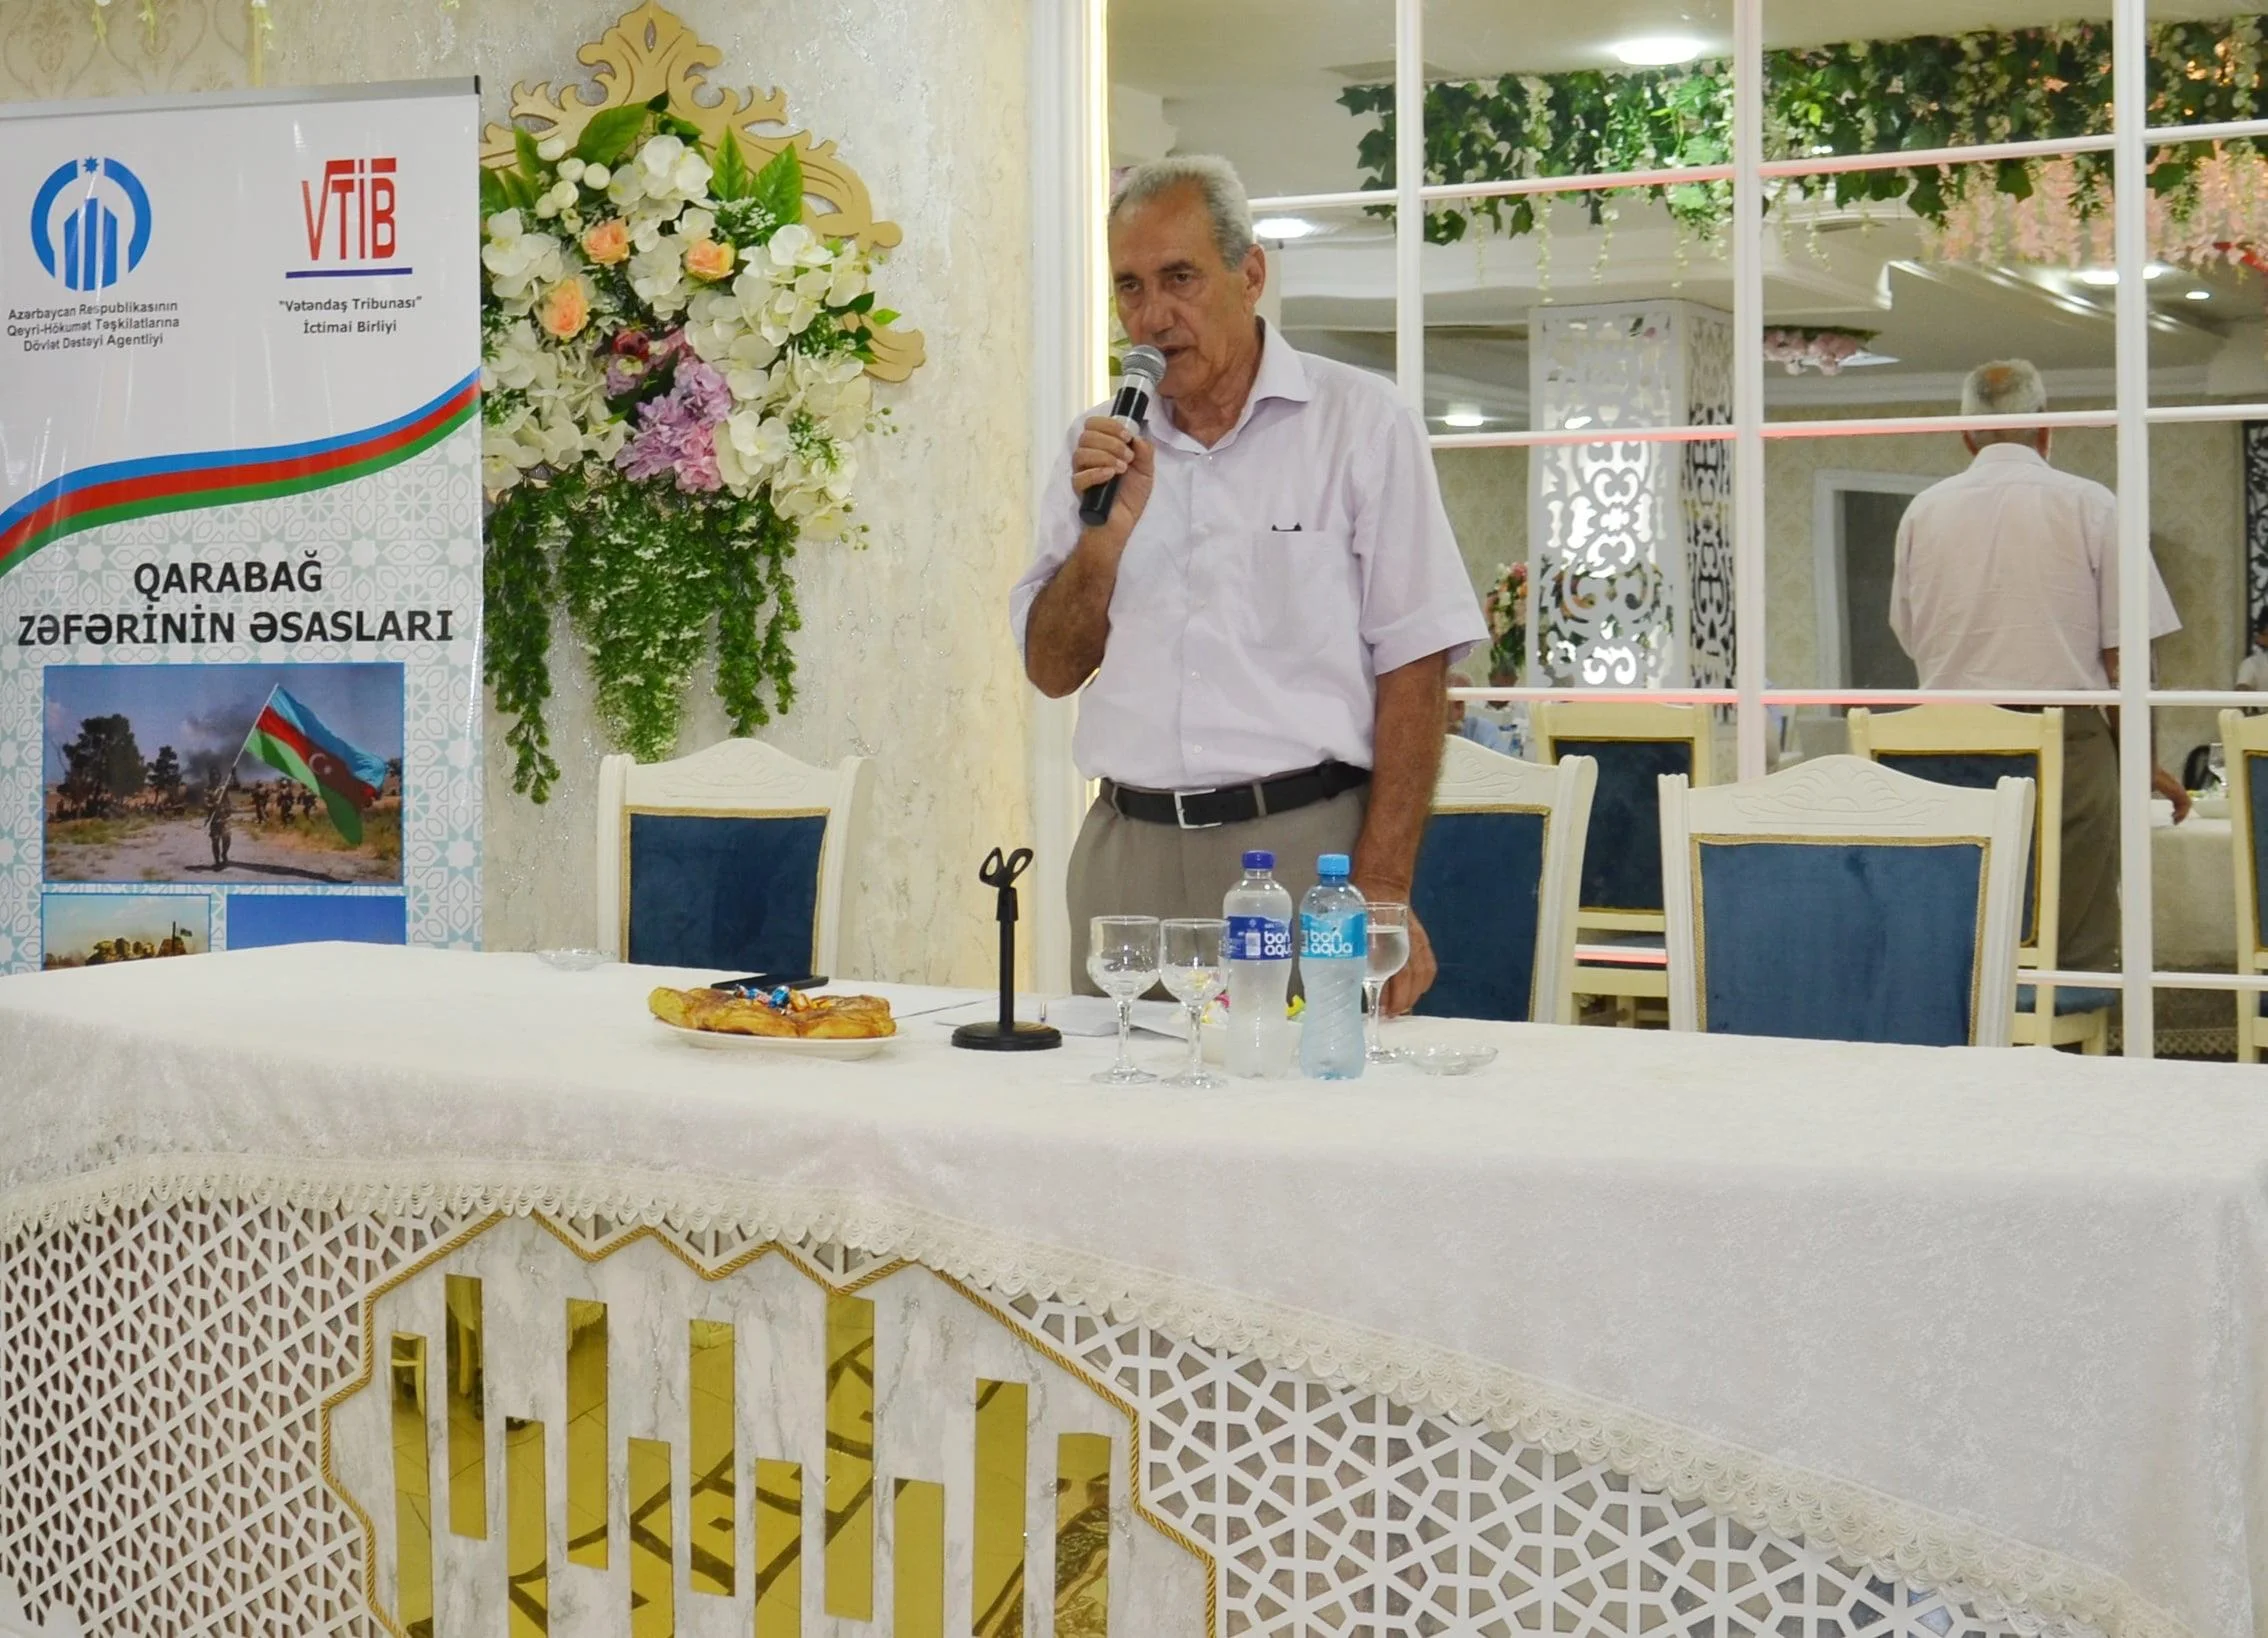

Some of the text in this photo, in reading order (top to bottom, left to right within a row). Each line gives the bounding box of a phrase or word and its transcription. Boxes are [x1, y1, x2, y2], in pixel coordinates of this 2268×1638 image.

[302, 157, 397, 261] VTİB
[8, 302, 178, 321] Azərbaycan Respublikasının
[279, 296, 422, 313] "Vətəndaş Tribunası"
[96, 317, 179, 331] Təşkilatlarına
[304, 320, 397, 334] İctimai Birliyi
[24, 333, 163, 352] Dövlət Dəstəyi Agentliyi
[134, 550, 322, 602] QARABAĞ
[18, 604, 454, 646] ZƏFƏRİNİN ƏSASLARI
[1311, 942, 1353, 956] aqua
